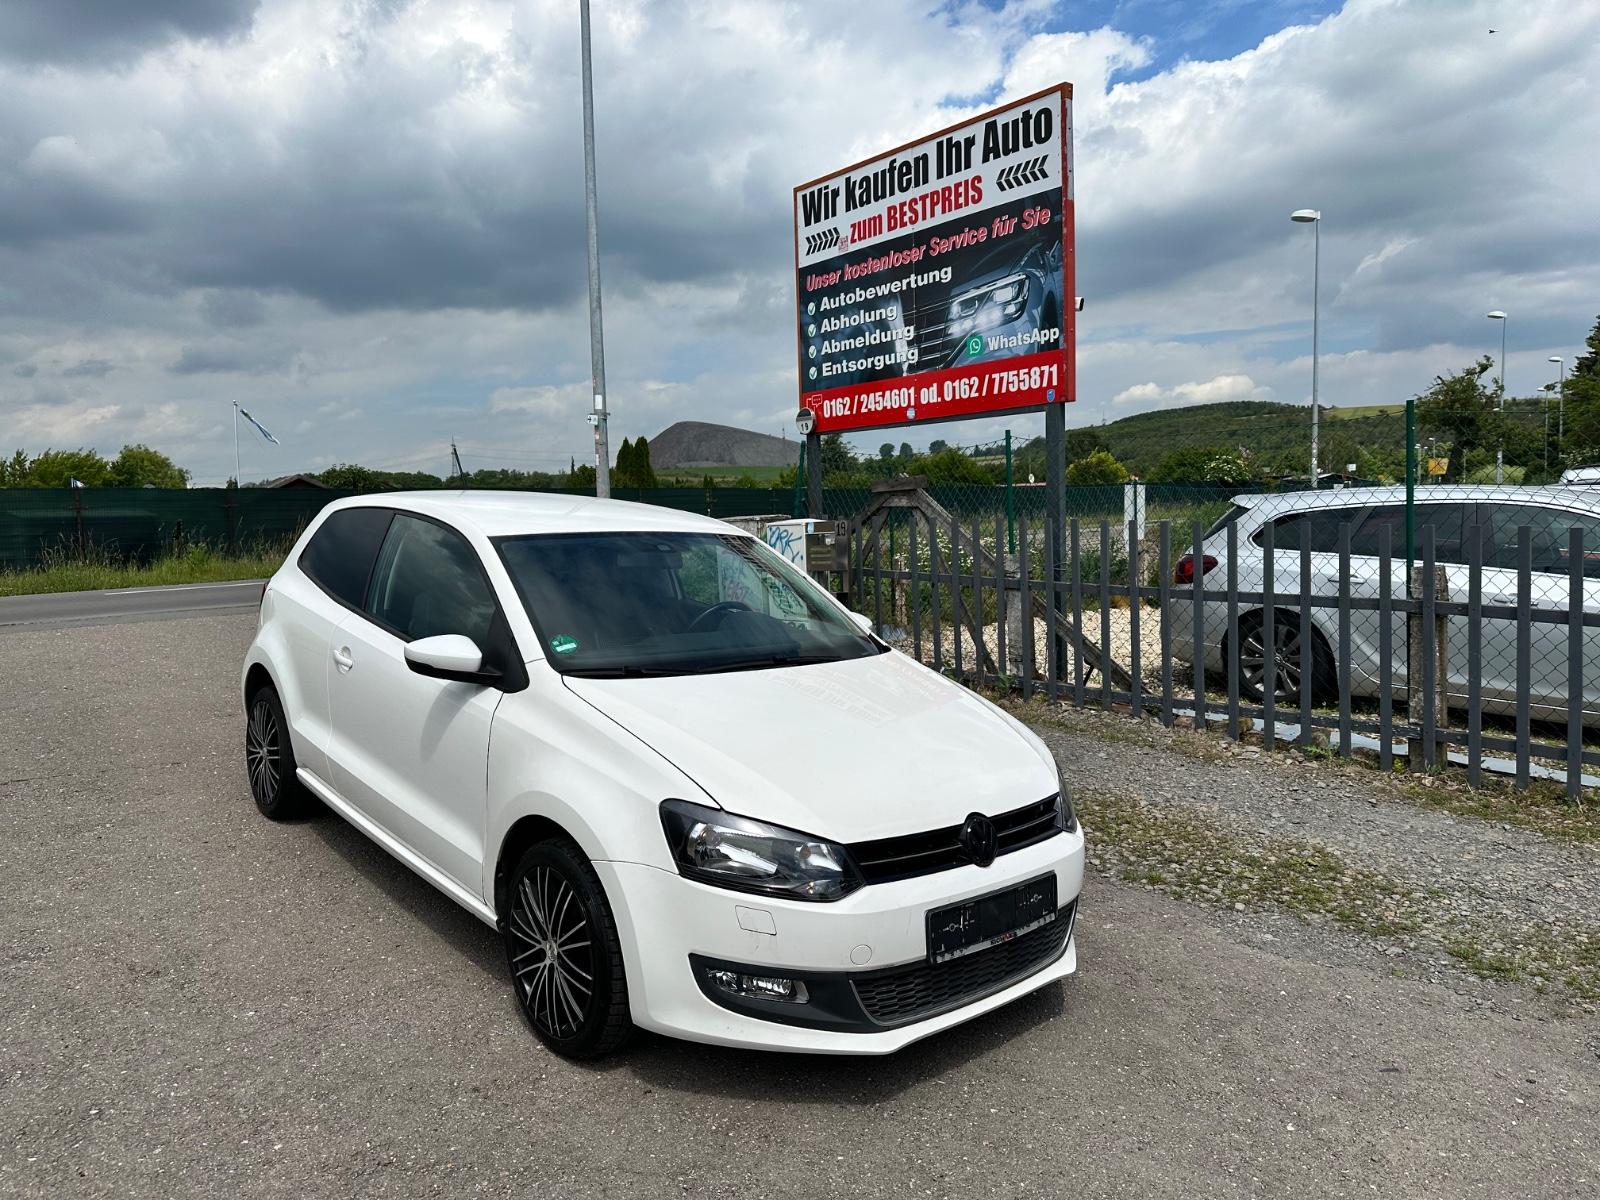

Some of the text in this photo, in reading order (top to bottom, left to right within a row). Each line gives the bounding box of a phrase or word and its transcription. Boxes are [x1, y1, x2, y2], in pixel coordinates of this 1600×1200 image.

[802, 107, 1053, 227] Wir kaufen Ihr Auto
[850, 175, 983, 245] zum BESTPREIS
[806, 269, 842, 293] Unser
[844, 243, 927, 281] kostenloser
[929, 226, 988, 255] Service
[991, 214, 1018, 239] für
[1021, 205, 1051, 231] Sie
[820, 265, 953, 313] Autobewertung
[820, 303, 898, 335] Abholung
[821, 323, 915, 356] Abmeldung
[987, 326, 1060, 351] WhatsApp
[822, 347, 919, 377] Entsorgung
[823, 397, 851, 420] 0162
[860, 387, 916, 414] 2454601
[920, 382, 942, 404] od.
[943, 376, 979, 402] 0162
[991, 364, 1059, 394] 7755871
